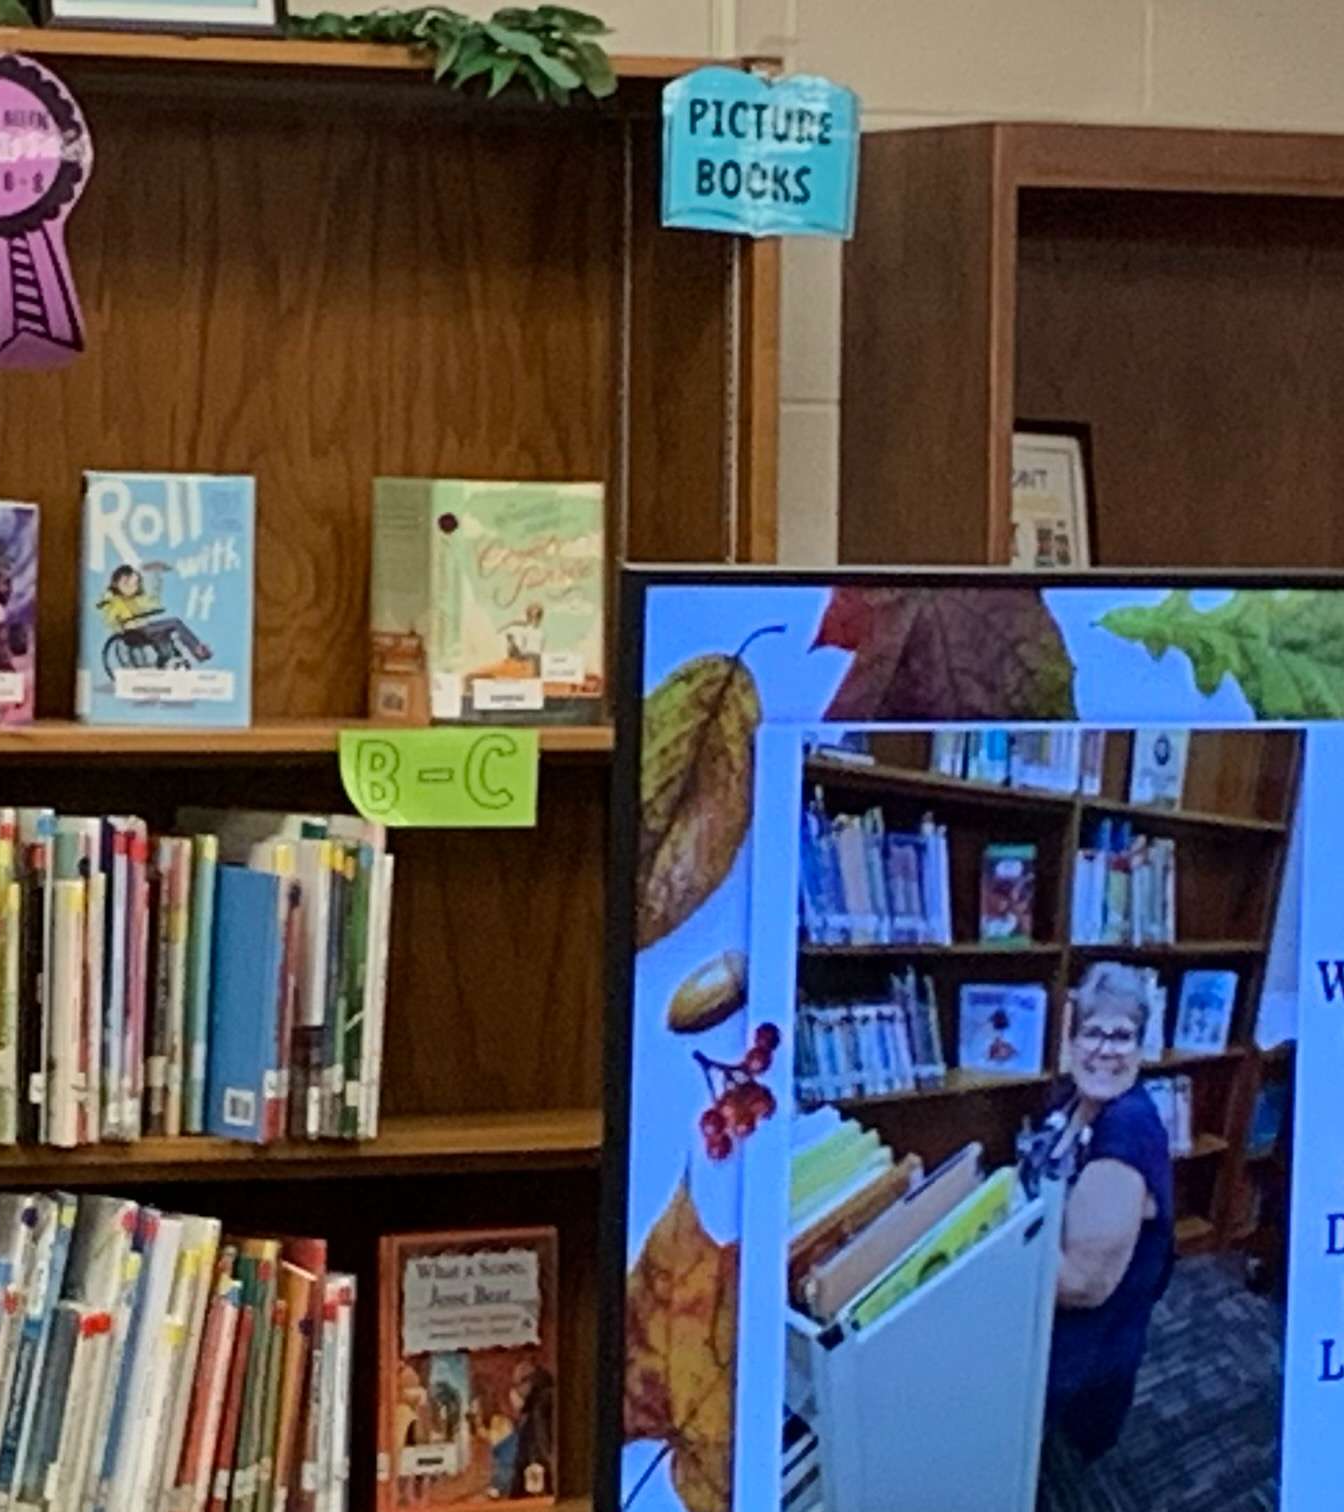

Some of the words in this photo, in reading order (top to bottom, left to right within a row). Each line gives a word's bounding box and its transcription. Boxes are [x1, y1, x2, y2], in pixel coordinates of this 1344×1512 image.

[689, 98, 834, 145] PICTURE
[696, 158, 812, 206] BOOKS
[87, 477, 204, 573] Roll
